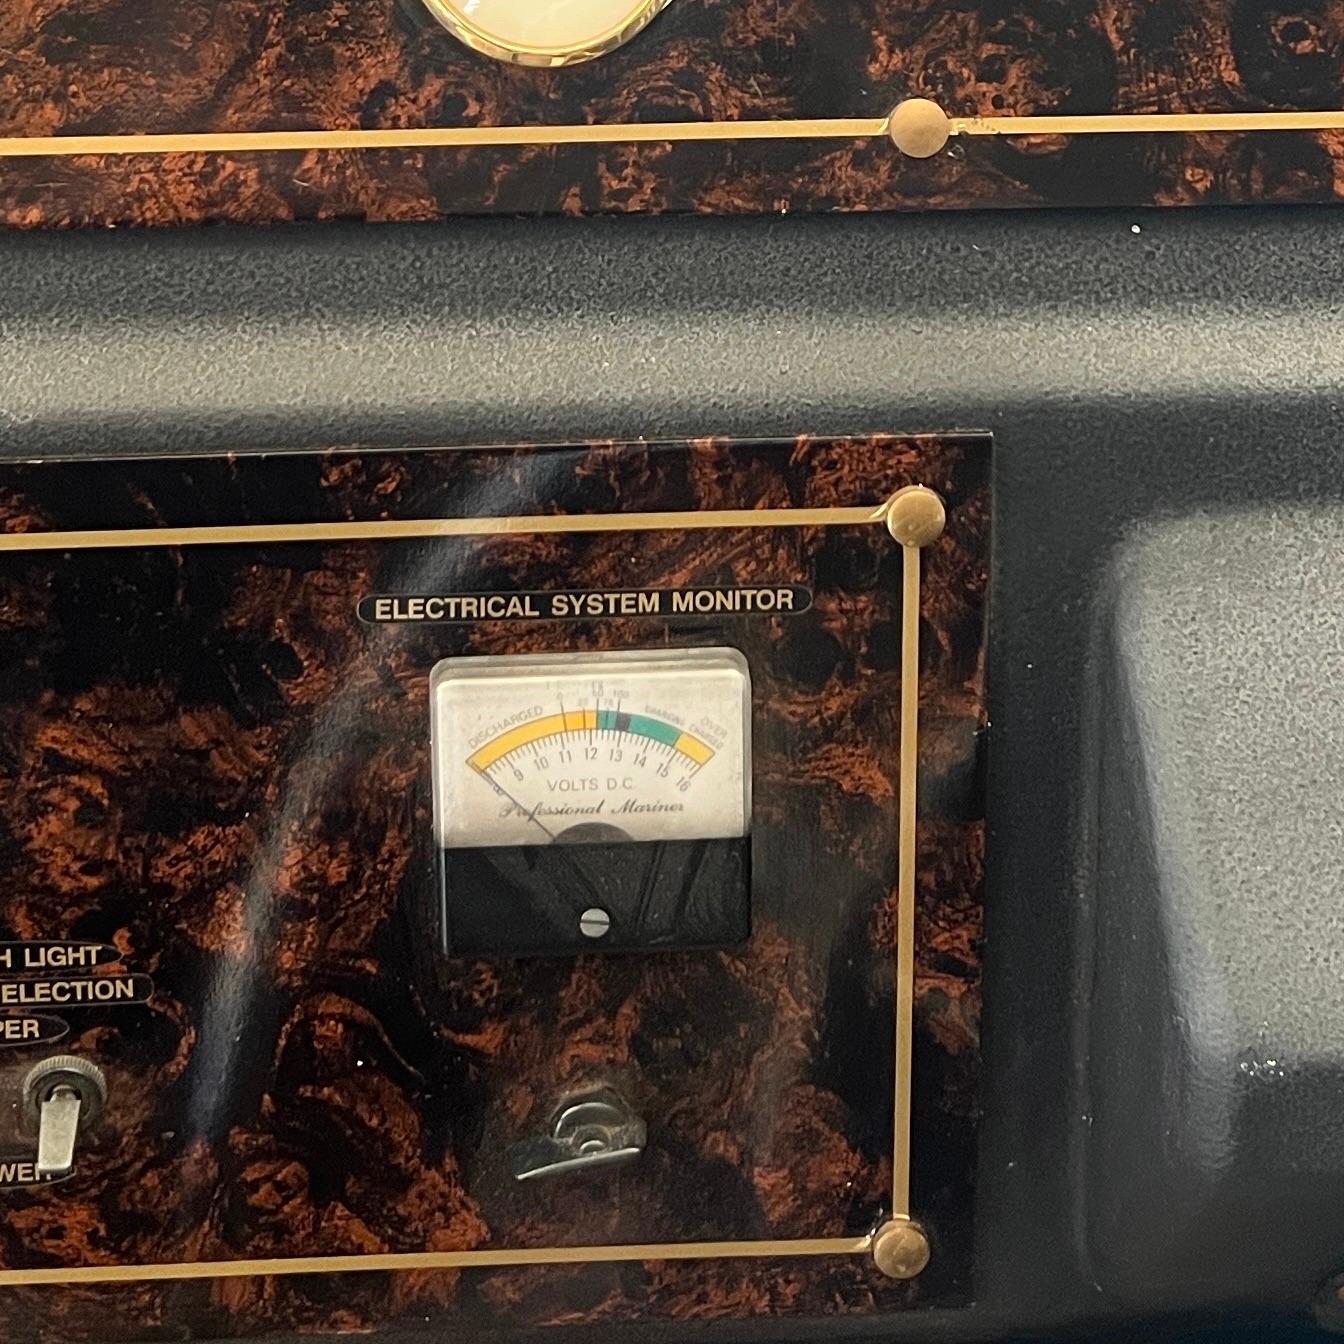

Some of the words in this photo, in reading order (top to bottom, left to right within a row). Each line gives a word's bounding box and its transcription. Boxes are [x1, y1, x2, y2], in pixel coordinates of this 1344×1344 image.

[375, 595, 539, 619] ELECTRICAL
[551, 591, 660, 616] SYSTEM
[672, 589, 794, 612] MONITOR
[468, 705, 544, 749] DISCHARGED
[559, 750, 573, 764] 11
[584, 747, 599, 761] 12
[609, 748, 623, 762] 13
[633, 754, 648, 768] 14
[534, 756, 549, 771] 10
[656, 763, 669, 778] 15
[513, 769, 524, 782] 9
[546, 778, 599, 792] VOLTS
[676, 776, 692, 793] 16
[611, 798, 684, 814] Mariner
[24, 946, 103, 968] LIGHT
